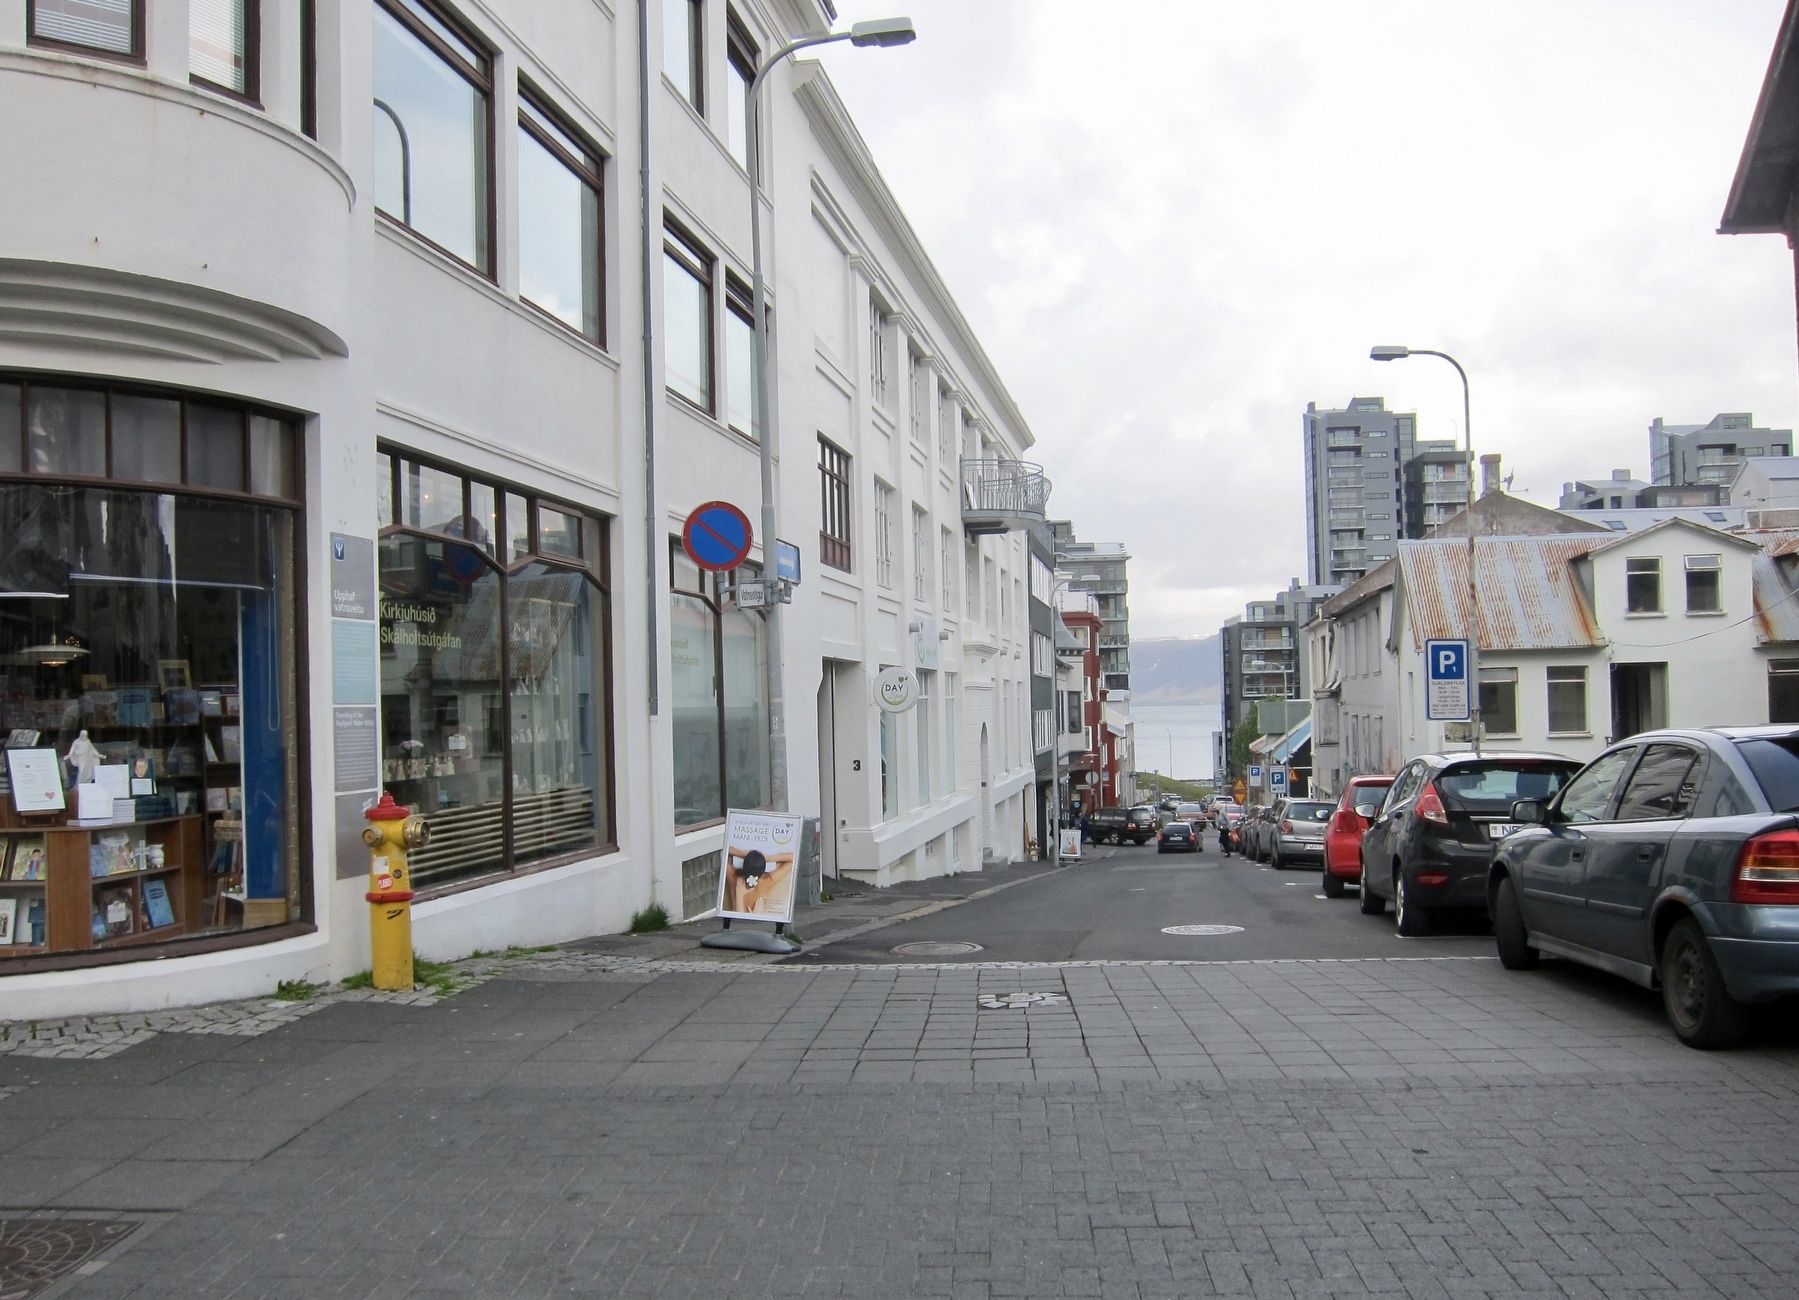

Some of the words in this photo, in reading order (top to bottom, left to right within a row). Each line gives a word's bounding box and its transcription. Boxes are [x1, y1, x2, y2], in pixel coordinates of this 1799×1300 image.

[380, 601, 436, 623] Kirkjuhúsið
[380, 626, 462, 651] Skálholtsútgáfan
[885, 684, 904, 692] DAY
[853, 759, 861, 771] 3
[1274, 773, 1281, 783] P
[734, 825, 769, 835] MASSAGE
